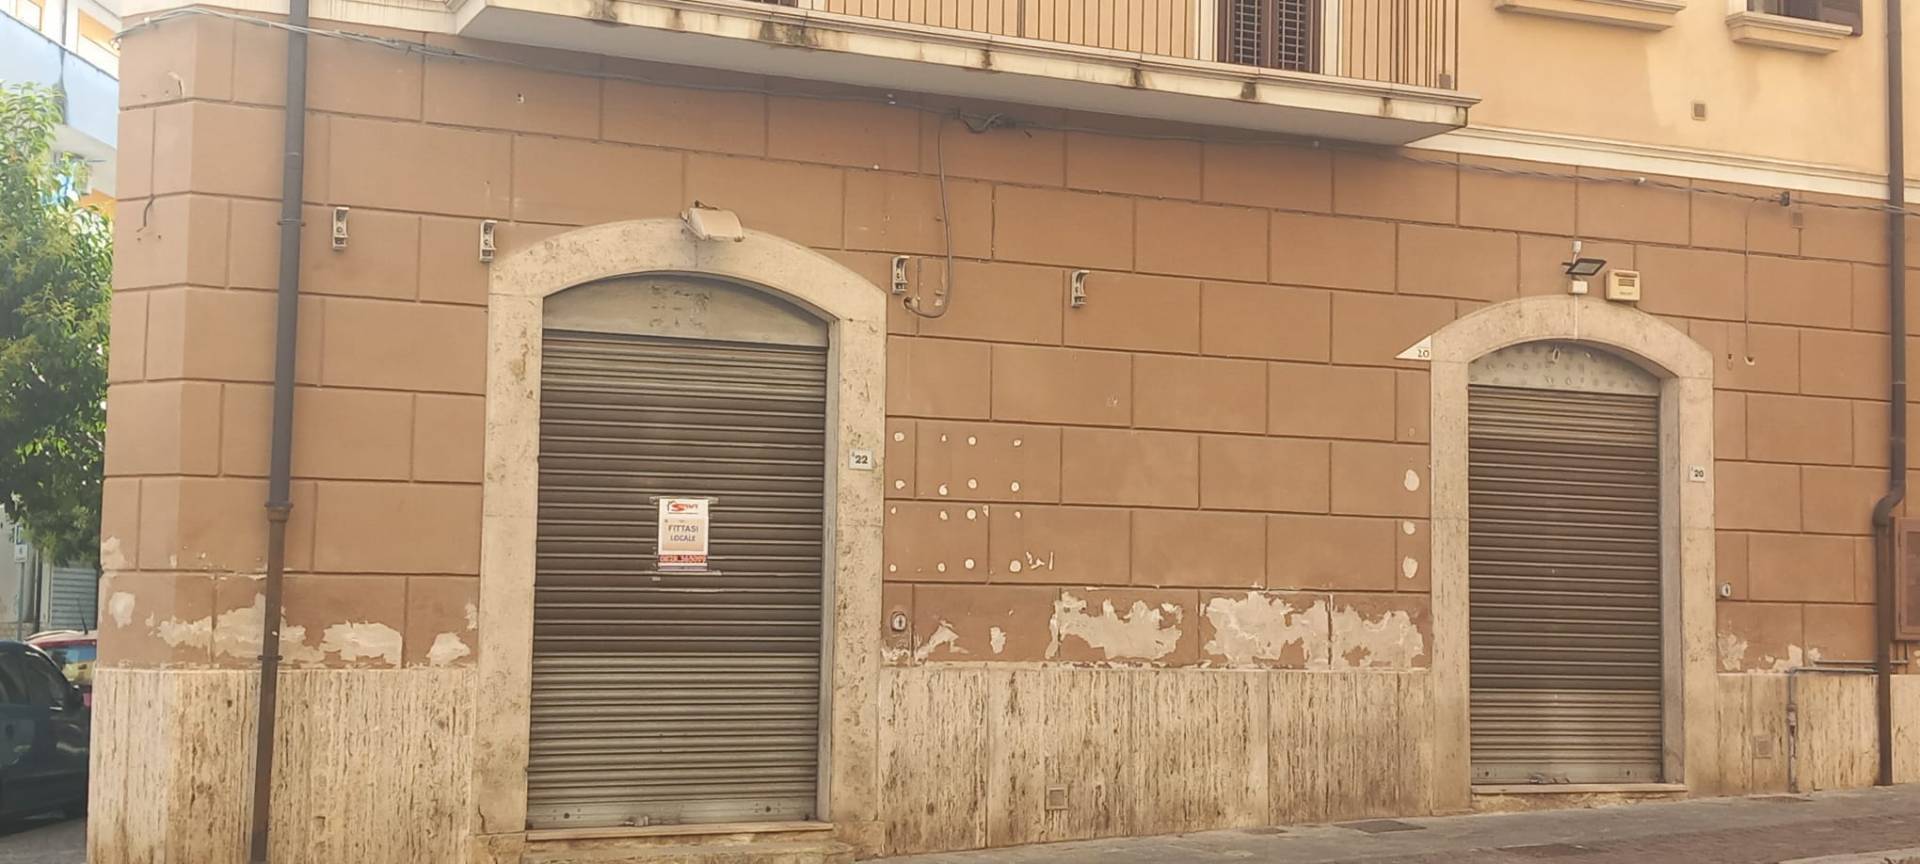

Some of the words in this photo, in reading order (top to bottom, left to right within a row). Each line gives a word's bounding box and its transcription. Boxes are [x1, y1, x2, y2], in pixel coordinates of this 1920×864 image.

[1417, 348, 1430, 358] 20
[855, 454, 868, 465] 22
[1694, 468, 1705, 478] 20
[668, 525, 699, 533] FITTASI
